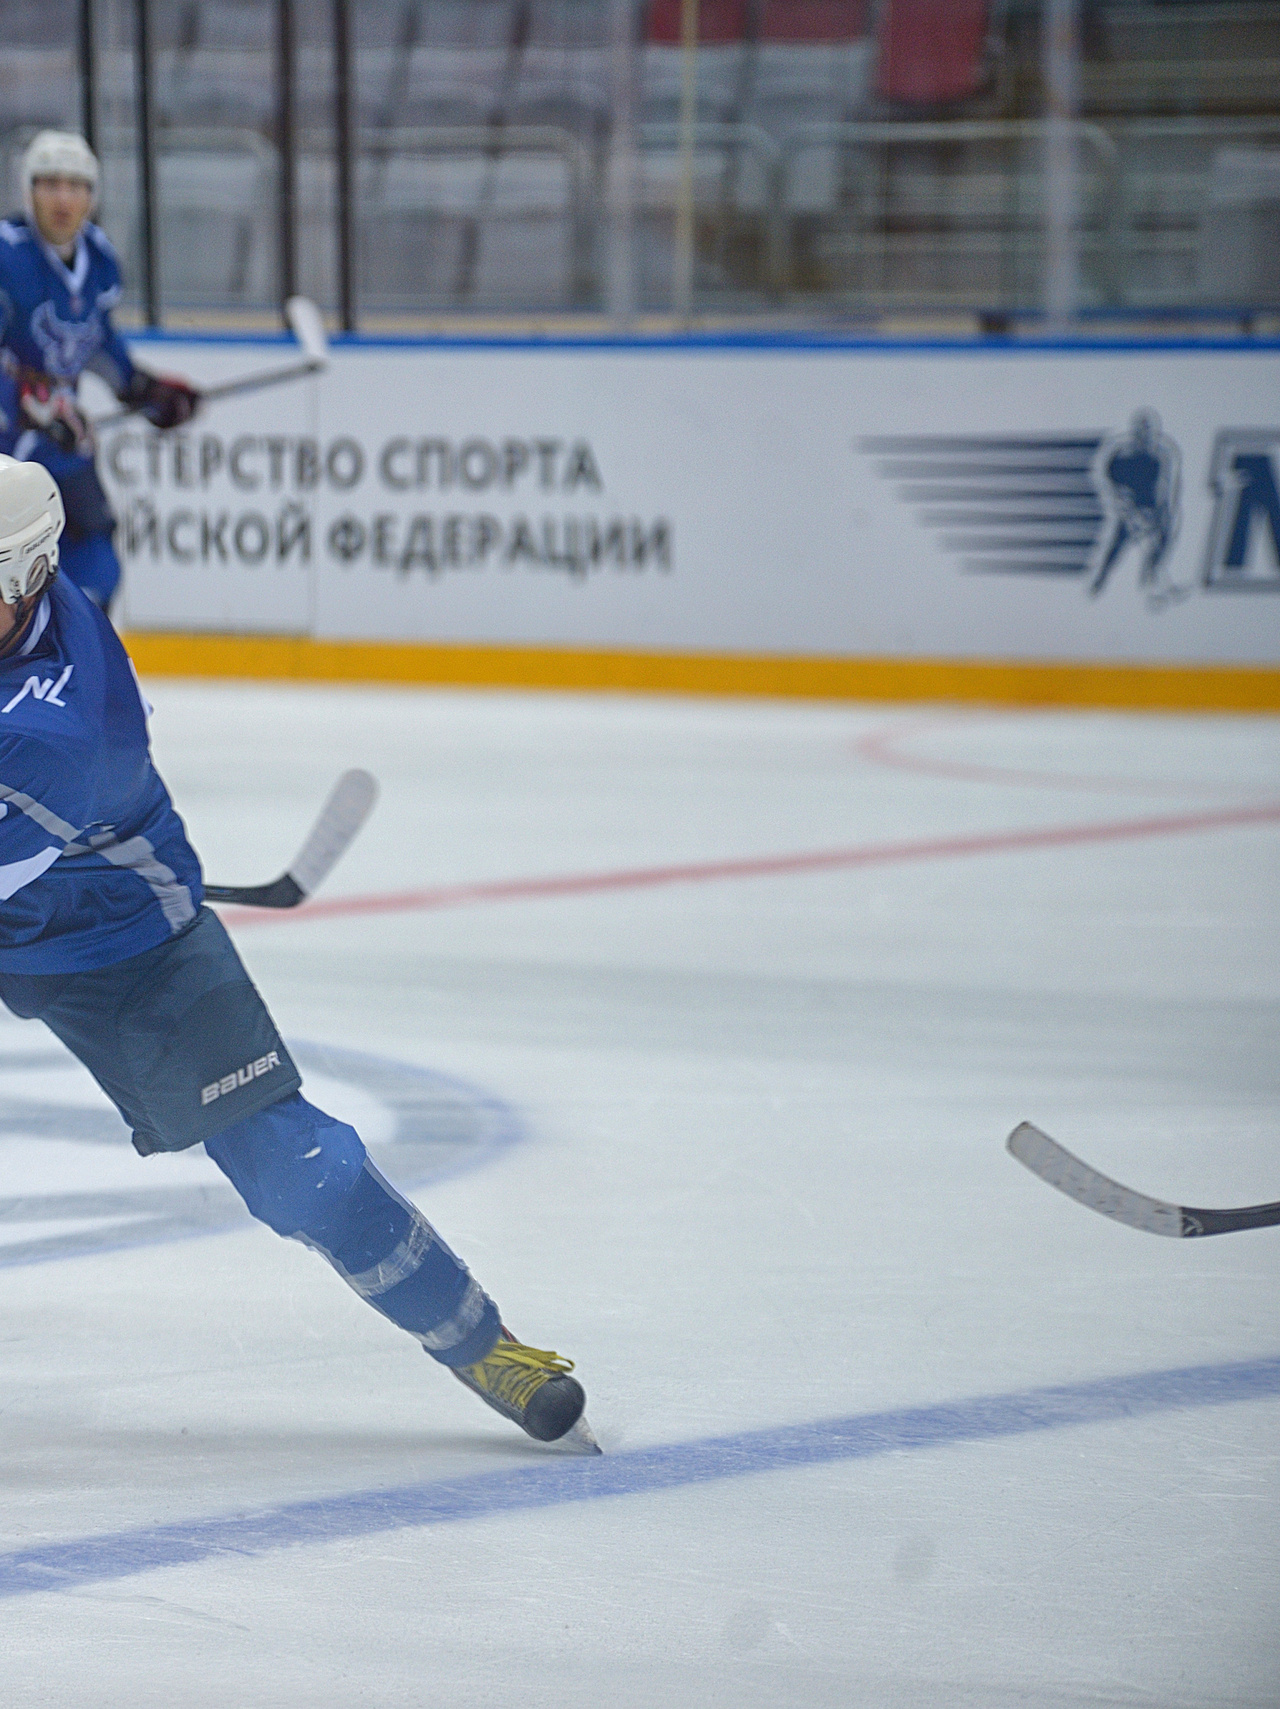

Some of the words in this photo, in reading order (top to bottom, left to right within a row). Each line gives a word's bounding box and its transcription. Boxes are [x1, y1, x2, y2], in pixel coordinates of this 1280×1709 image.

[378, 435, 605, 492] СПОРТА
[325, 510, 676, 582] ФЕДЕРАЦИИ
[200, 1050, 281, 1106] BAUER
